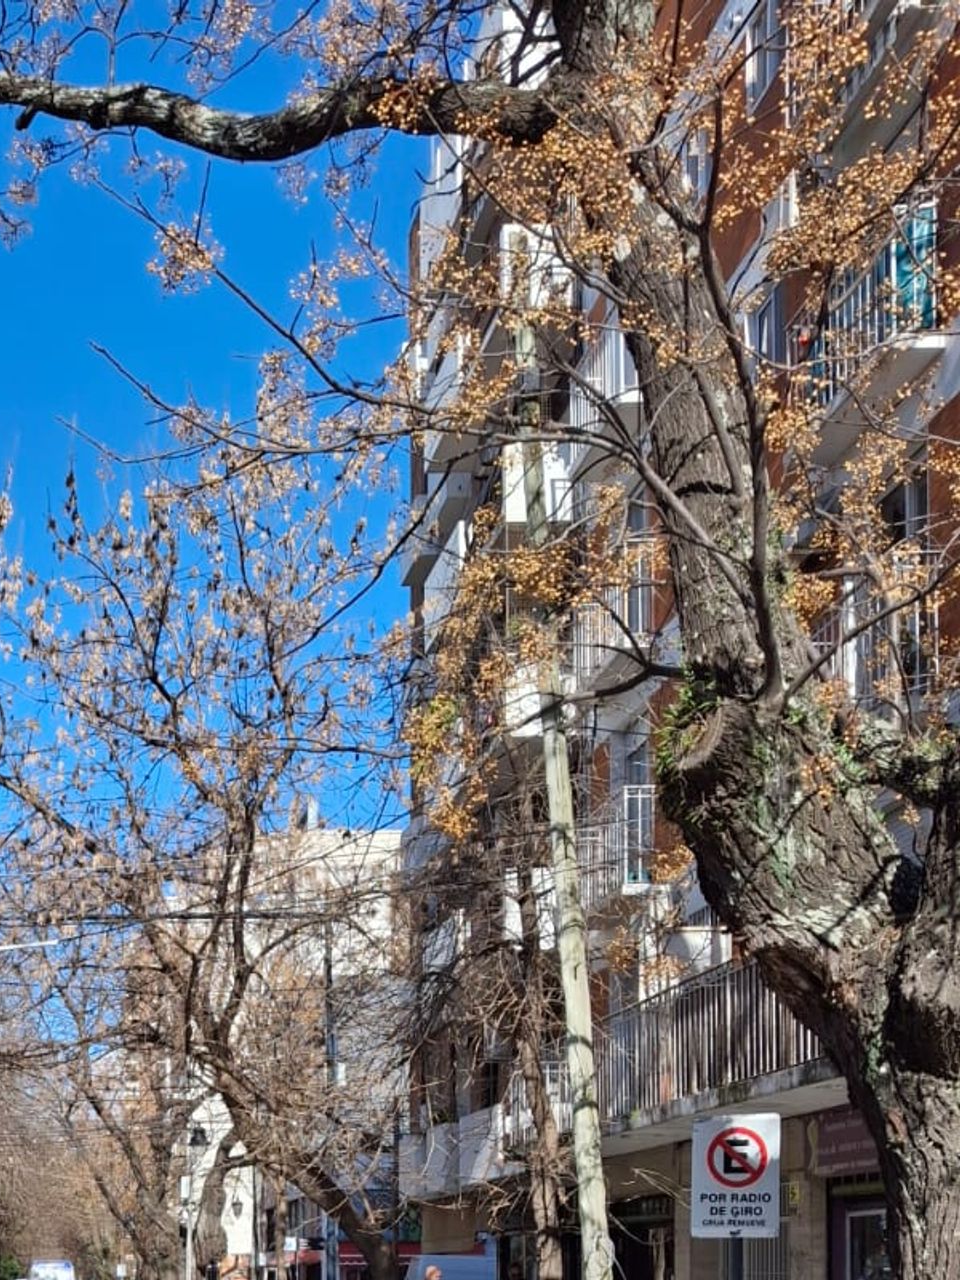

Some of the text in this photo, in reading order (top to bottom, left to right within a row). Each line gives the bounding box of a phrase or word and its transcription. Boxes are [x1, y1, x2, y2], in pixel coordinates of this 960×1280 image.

[723, 1139, 750, 1174] E
[700, 1193, 771, 1203] POR RADIO
[710, 1206, 763, 1217] DE GIRO
